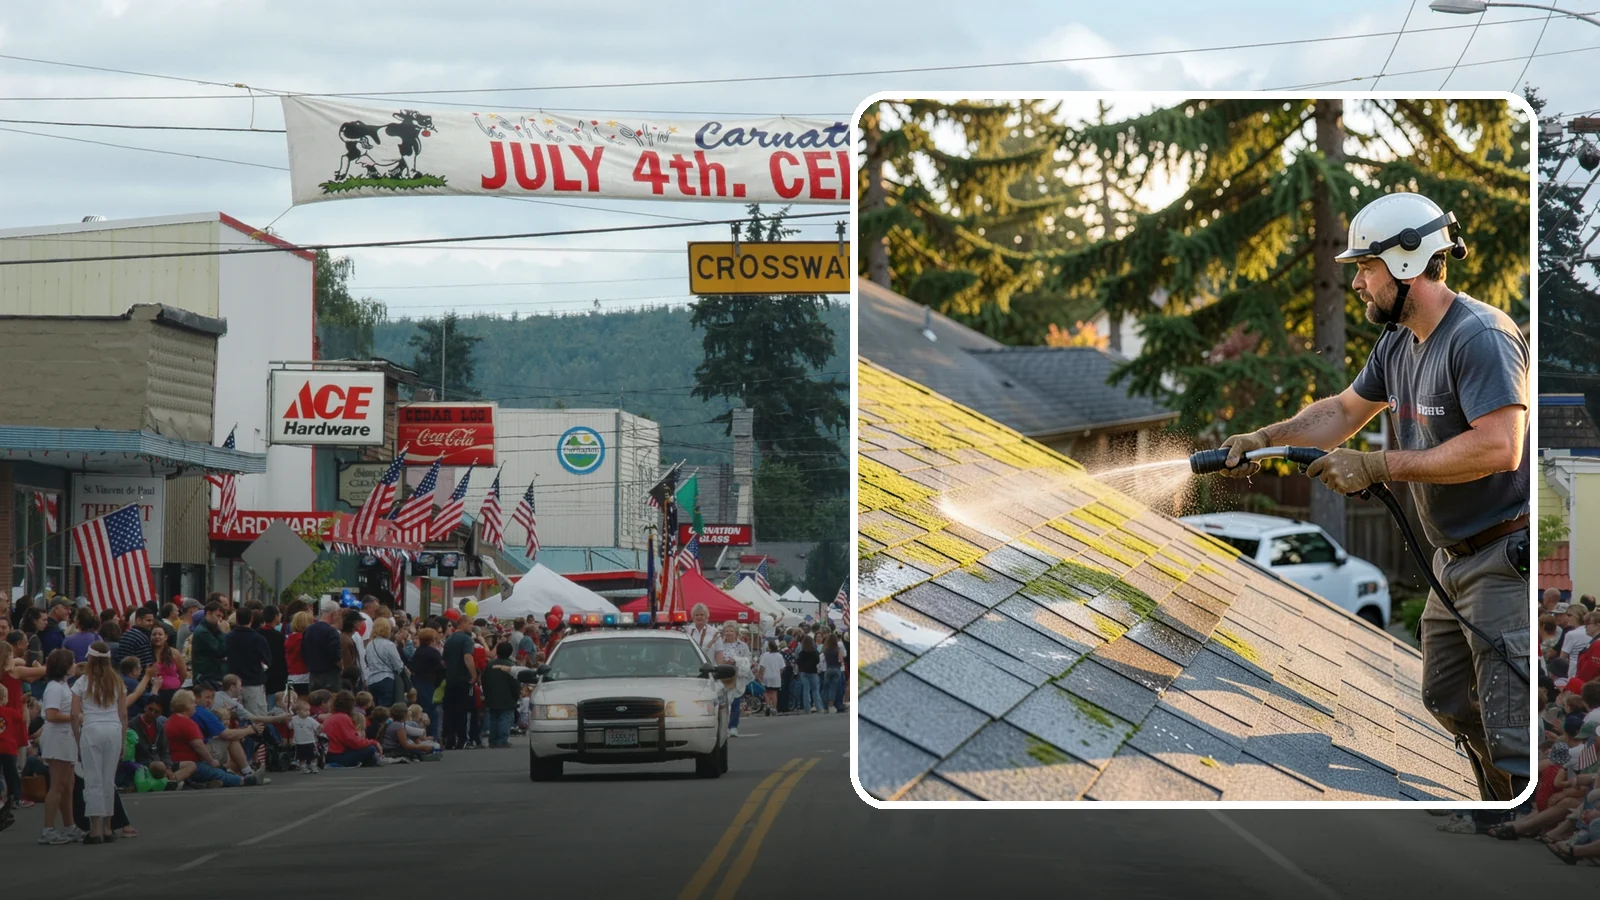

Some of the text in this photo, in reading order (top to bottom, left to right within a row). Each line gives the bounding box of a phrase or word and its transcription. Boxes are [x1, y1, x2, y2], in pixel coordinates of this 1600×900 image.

[481, 140, 605, 193] JULY
[632, 149, 747, 198] 4th.
[696, 253, 851, 280] CROSSWA
[282, 379, 374, 420] ACE
[405, 409, 453, 422] CEDAR
[283, 420, 371, 437] Hardware
[416, 427, 478, 447] Coca-Cola
[353, 467, 386, 480] Simpl
[95, 484, 124, 495] Vincent
[125, 485, 136, 495] de
[137, 485, 155, 495] Paul
[688, 526, 741, 535] CRNATION
[699, 535, 730, 543] GLASS
